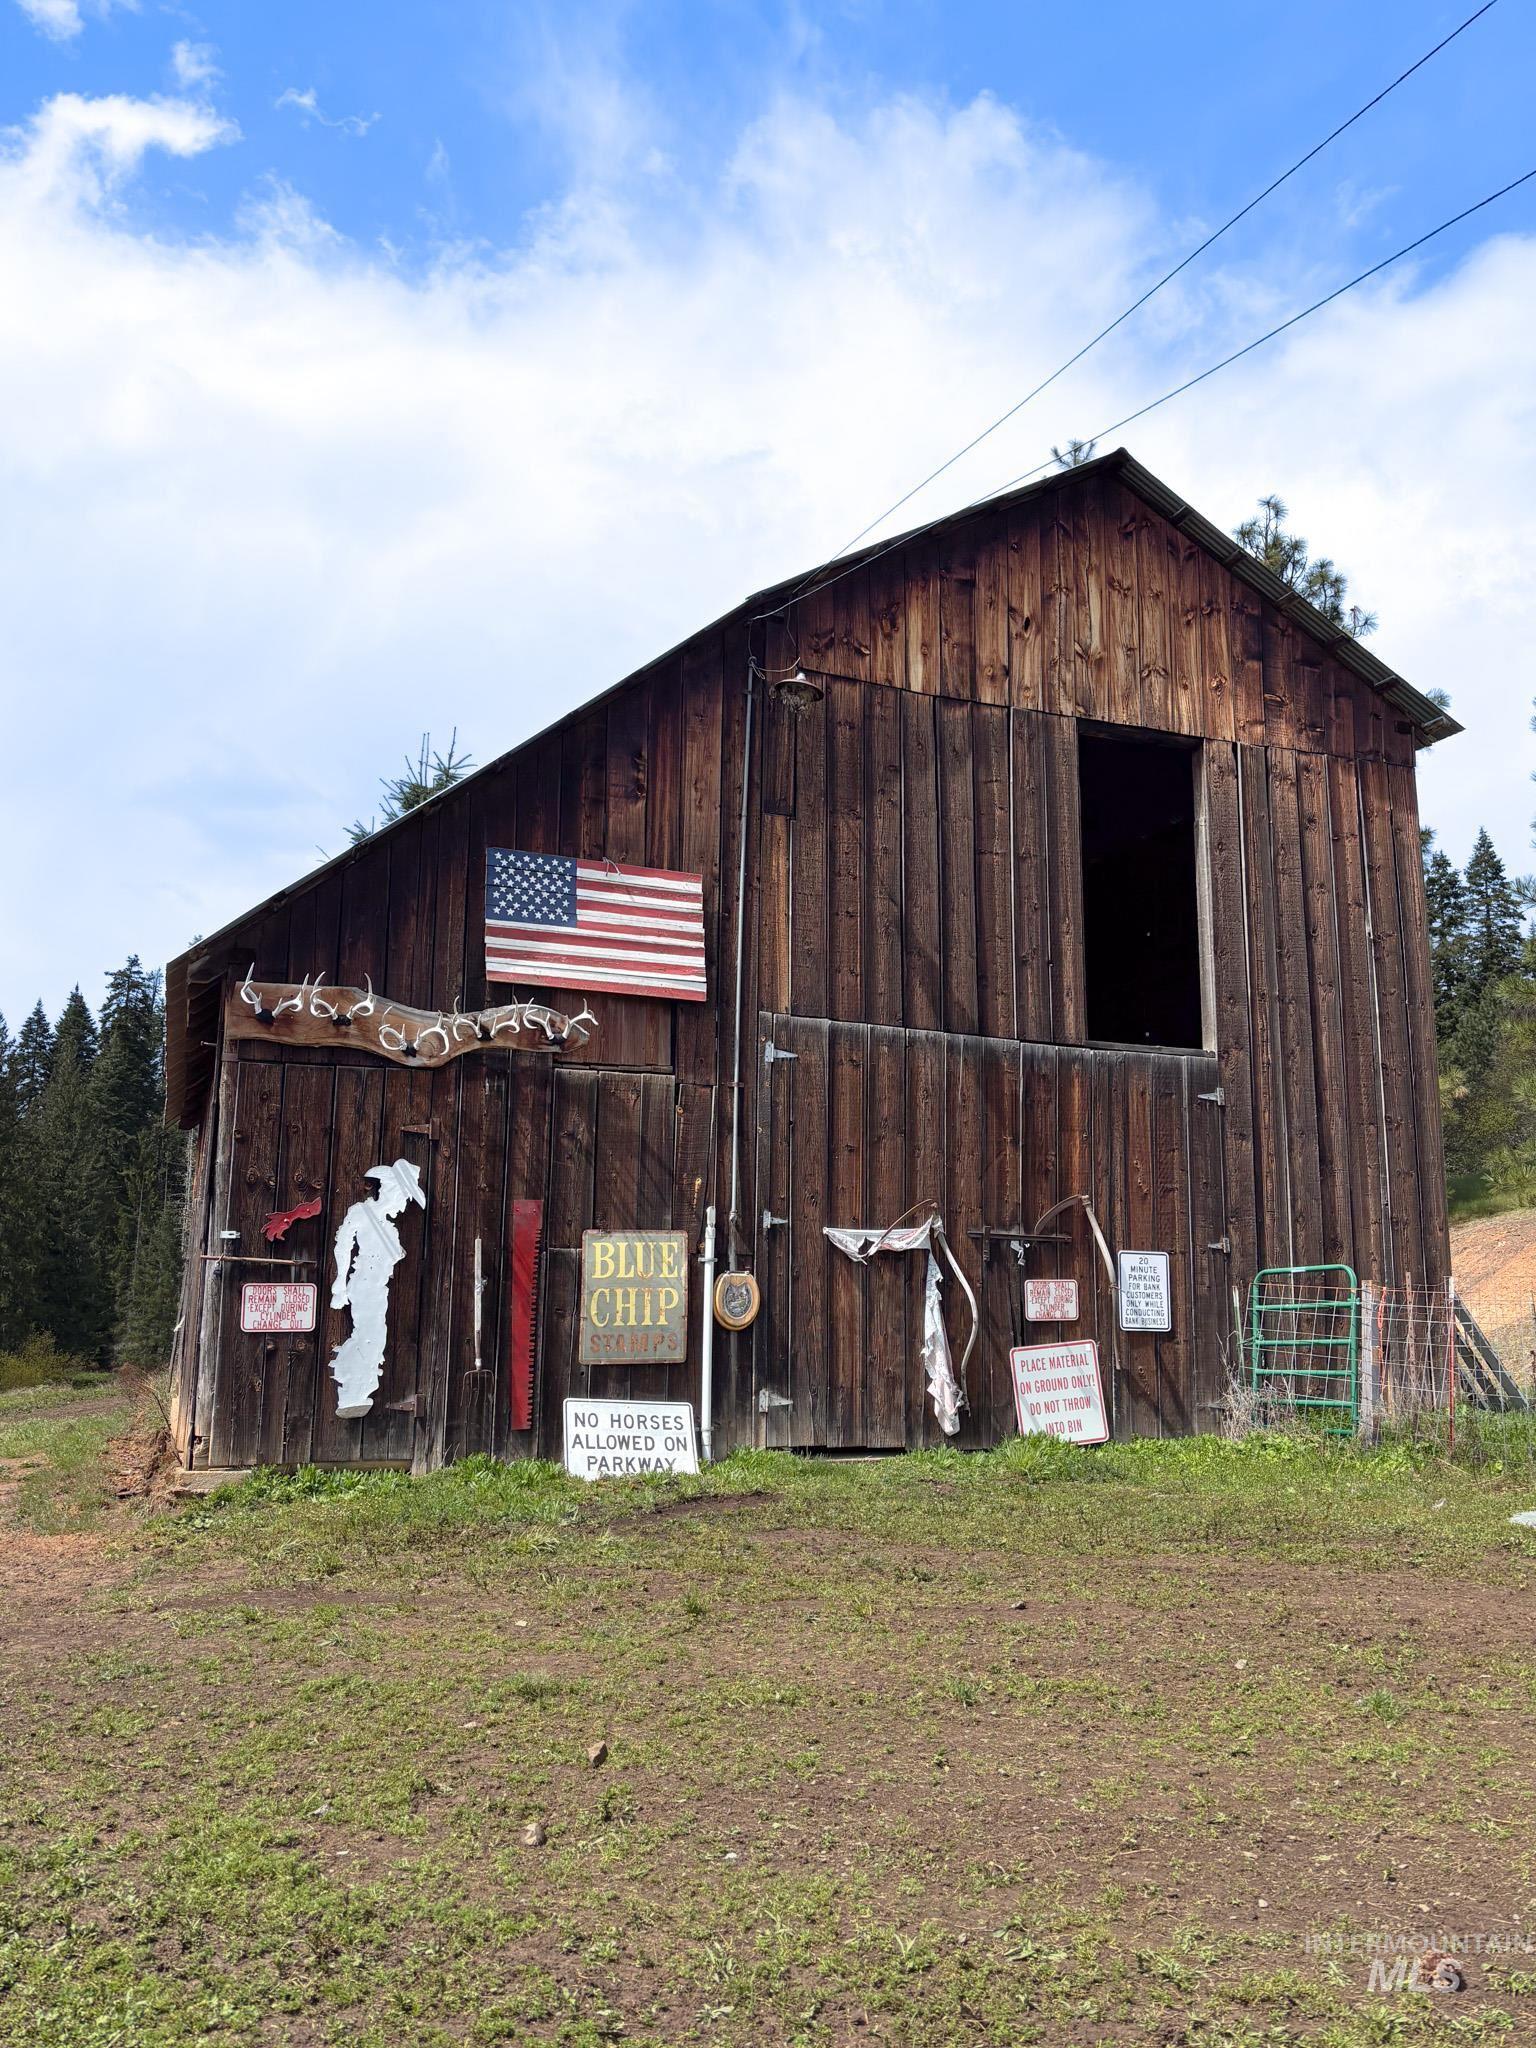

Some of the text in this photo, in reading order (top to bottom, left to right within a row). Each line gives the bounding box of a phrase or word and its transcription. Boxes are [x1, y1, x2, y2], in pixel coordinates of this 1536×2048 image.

[592, 1242, 678, 1279] BLUE
[1139, 1257, 1149, 1265] 20
[1130, 1266, 1157, 1274] MINUTE
[1128, 1274, 1160, 1282] PARKING
[253, 1286, 305, 1295] DOORS SHALL
[1128, 1282, 1160, 1291] FOR BANK
[248, 1295, 310, 1303] REMAIN CLOSED
[1126, 1291, 1163, 1299] CUSTOMERS
[249, 1303, 308, 1312] EXCEPT DURING
[591, 1287, 679, 1327] CHIP
[1126, 1300, 1141, 1308] ONLY
[260, 1312, 297, 1320] CYLINDER
[1126, 1309, 1164, 1317] CONDUCTING
[253, 1320, 303, 1329] CHANGE OUT
[1141, 1318, 1166, 1326] BUSINESS
[590, 1332, 677, 1353] STAMPS
[1021, 1353, 1089, 1373] PLACE MATERIAL
[1020, 1374, 1096, 1395] ON GROUND ONLY!
[1030, 1396, 1091, 1416] DO NOT THROW
[574, 1412, 684, 1431] NO HORSES
[1045, 1419, 1083, 1435] INTO BIN
[571, 1434, 688, 1452] ALLOWED ON
[587, 1456, 677, 1472] PARKWAY
